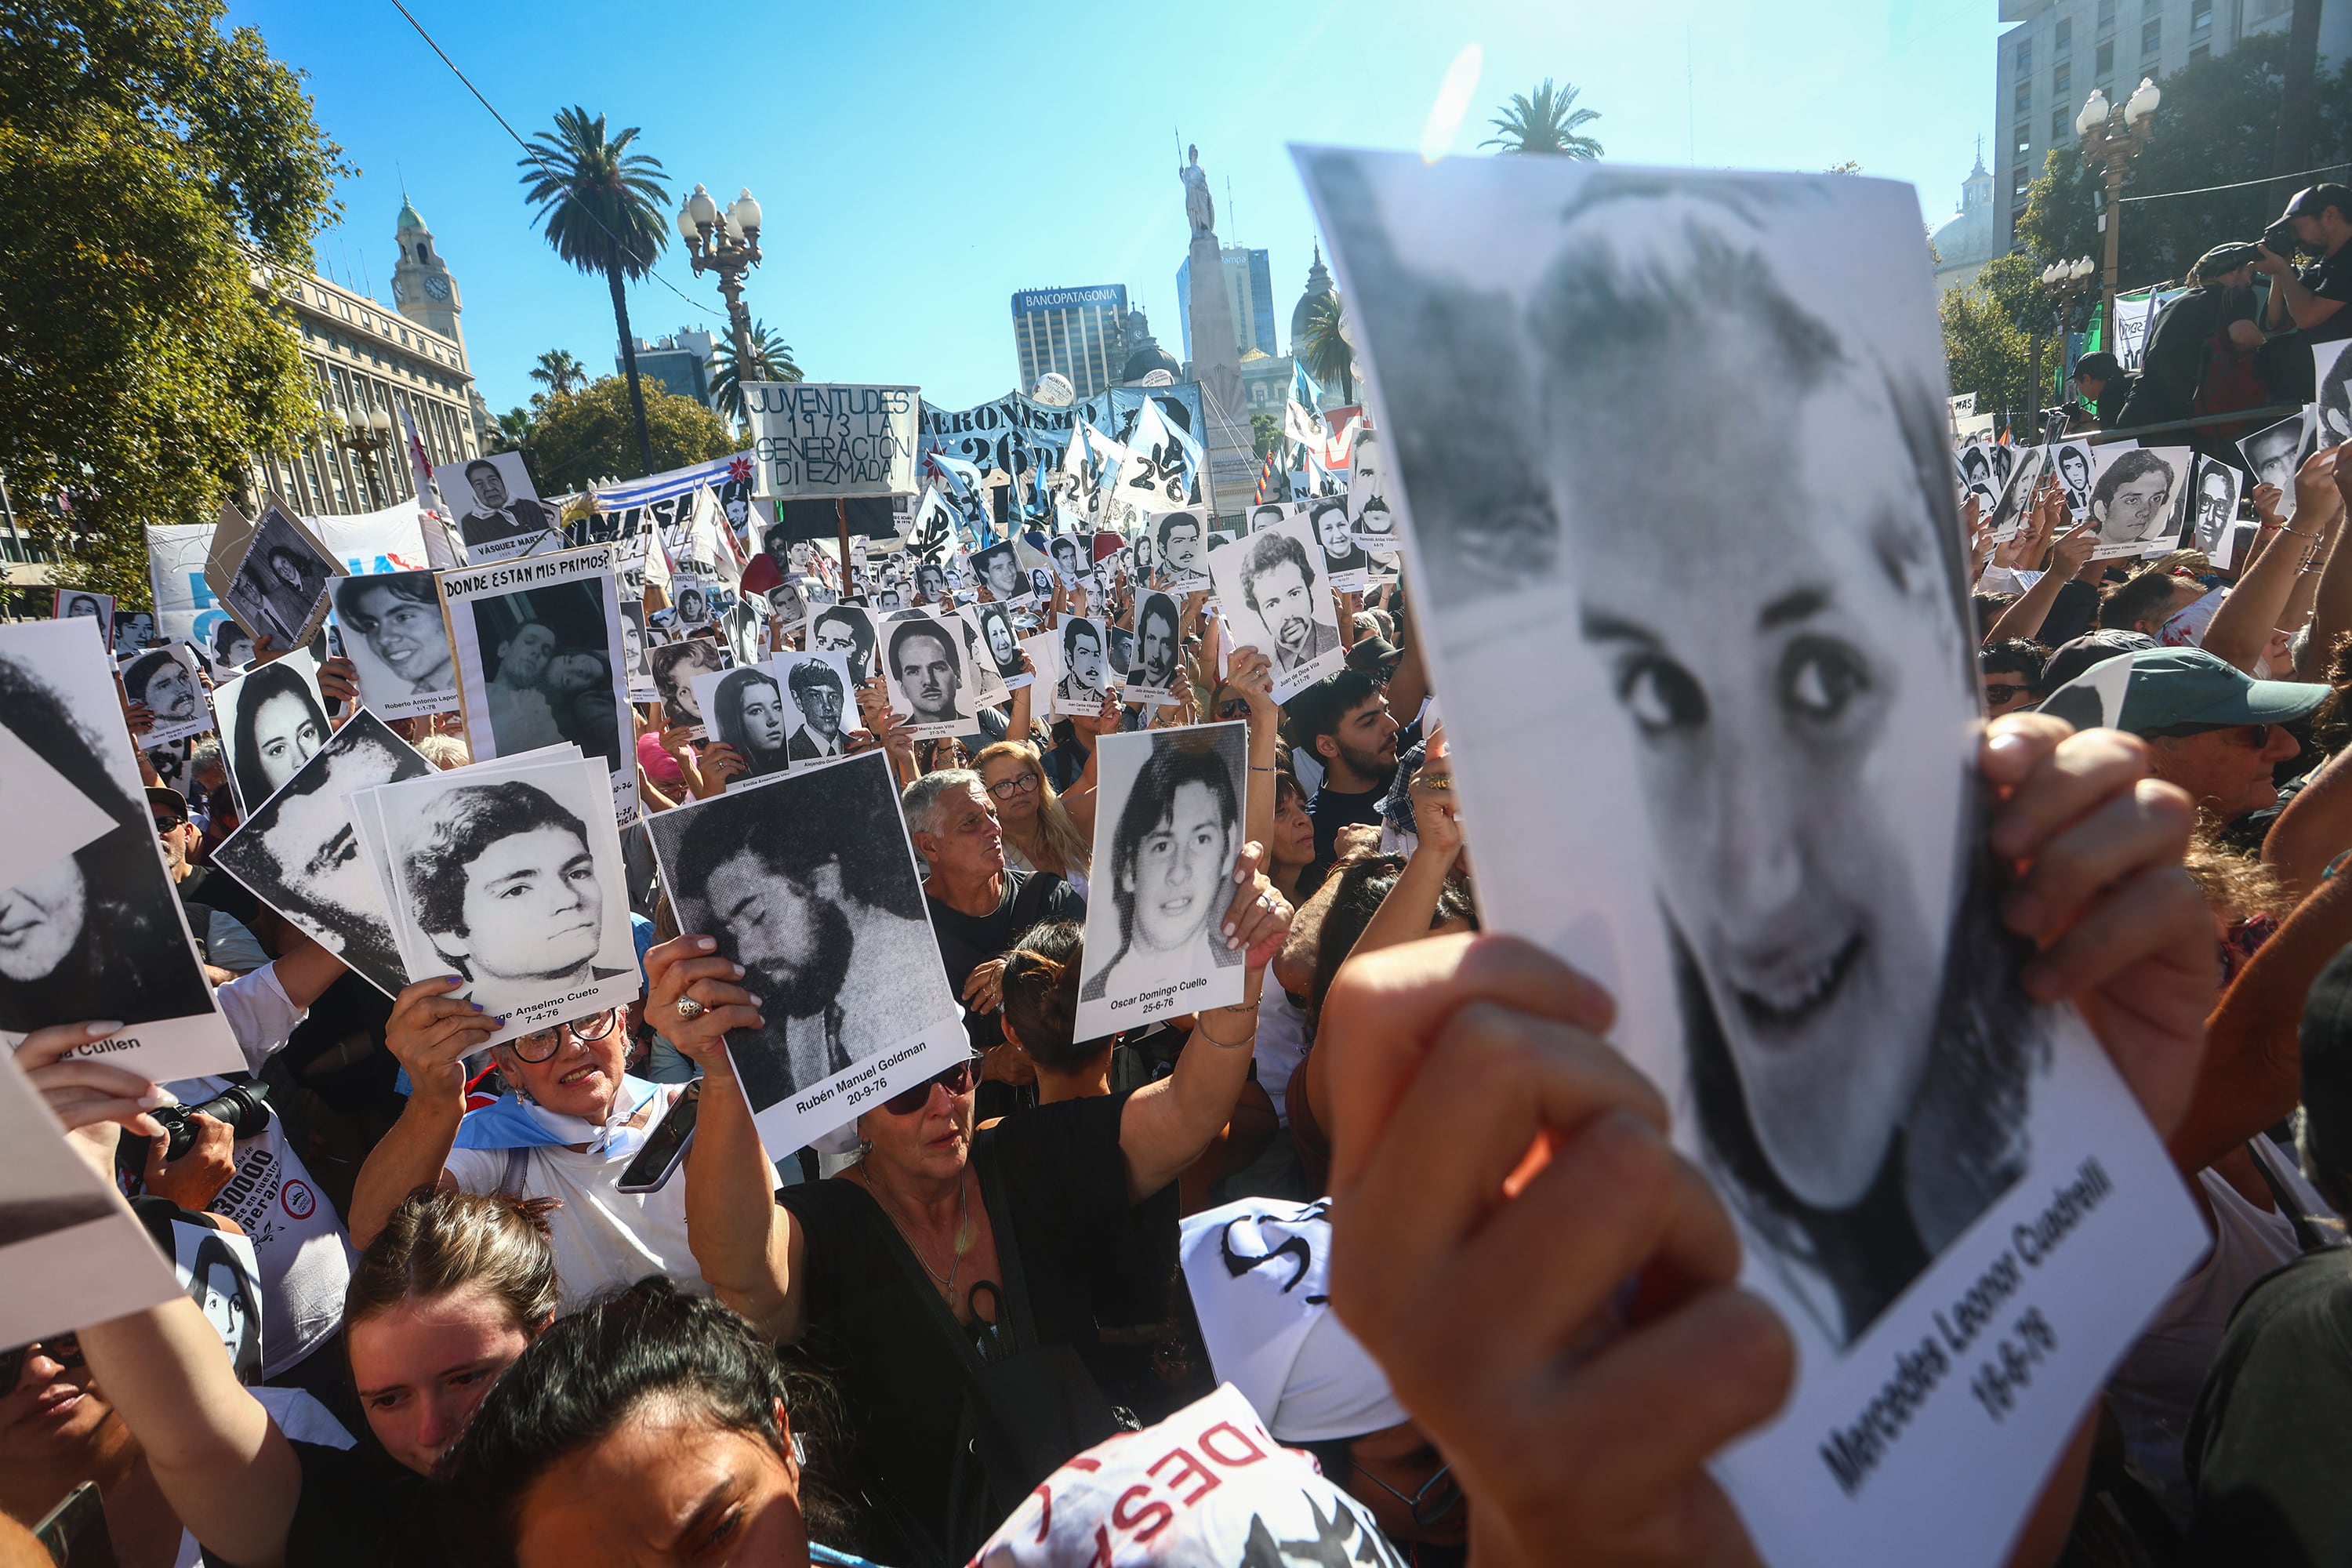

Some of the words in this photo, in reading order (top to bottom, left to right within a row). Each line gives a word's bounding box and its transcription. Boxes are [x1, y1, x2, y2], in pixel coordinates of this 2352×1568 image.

[1025, 289, 1117, 307] BANCOPATAGONIA
[750, 388, 909, 415] JUVENTUDES
[787, 412, 851, 437] 1973
[866, 412, 895, 437] LA
[756, 436, 910, 462] GENERACION
[776, 459, 894, 485] DIEZMADA
[477, 540, 516, 556] VÁSQUEZ
[444, 575, 488, 597] DONDE
[492, 567, 533, 587] ESTAN
[536, 562, 556, 579] MIS
[560, 549, 610, 575] PRIMOS?
[1280, 677, 1291, 687] Juan
[1298, 668, 1309, 677] Dios
[384, 701, 412, 710] Roberto
[412, 696, 437, 706] Antonio
[516, 997, 564, 1016] Anselmo
[567, 987, 599, 1001] Cueto
[1110, 996, 1138, 1010] Oscar
[1139, 985, 1177, 1002] Domingo
[1179, 978, 1207, 991] Cuello
[1142, 997, 1174, 1014] 25-6-76
[524, 1008, 559, 1024] 7-4-76
[78, 1036, 141, 1057] Cullen
[796, 1088, 835, 1115] Rubén
[836, 1065, 877, 1094] Manuel
[878, 1041, 927, 1071] Goldman
[847, 1077, 887, 1105] 20-9-76
[244, 1145, 253, 1157] de
[213, 1149, 274, 1216] 30000
[246, 1193, 257, 1208] en
[1819, 1334, 1951, 1499] Mercedes
[1931, 1249, 2024, 1355] Leonor
